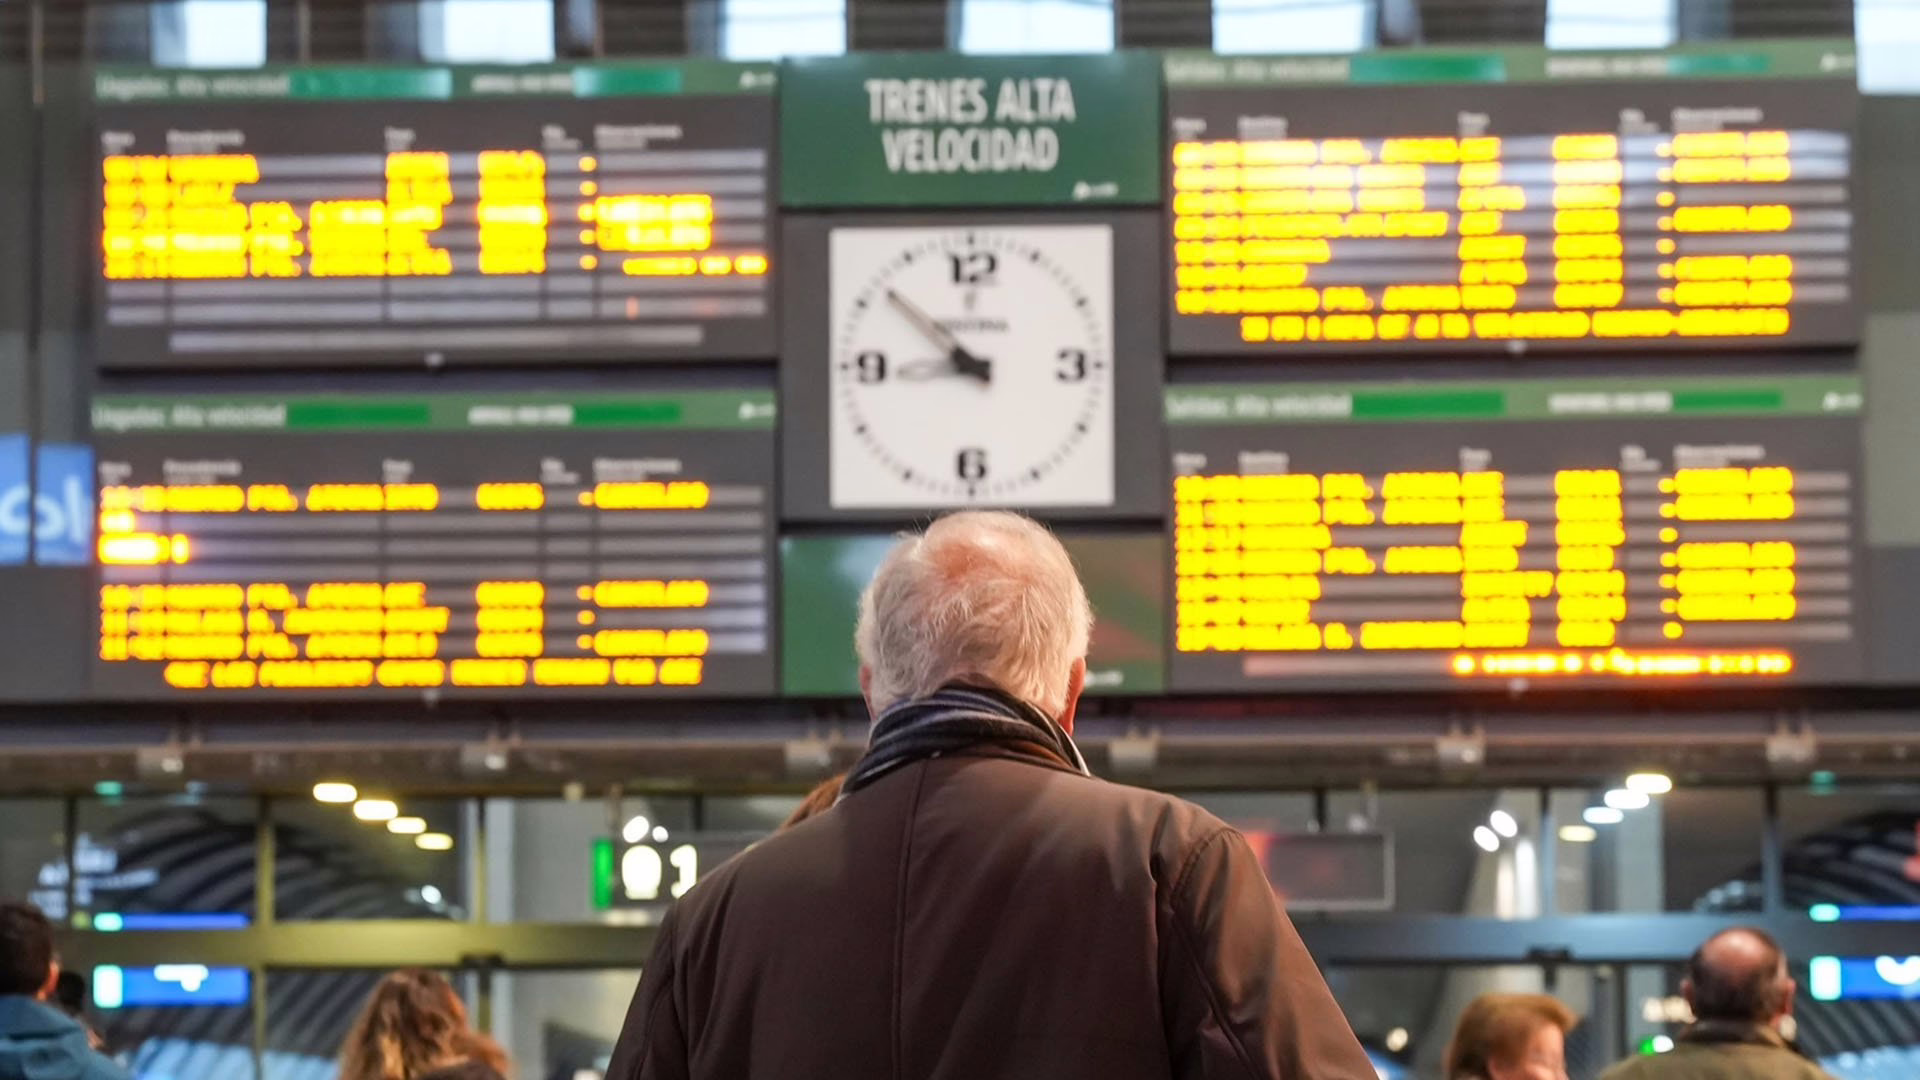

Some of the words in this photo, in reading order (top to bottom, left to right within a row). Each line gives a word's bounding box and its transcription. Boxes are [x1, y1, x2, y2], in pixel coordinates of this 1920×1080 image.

[865, 78, 987, 123] TRENES
[996, 77, 1076, 122] ALTA
[882, 127, 1059, 173] VELOCIDAD
[950, 253, 997, 284] 12
[856, 352, 887, 384] 9
[1057, 350, 1087, 381] 3
[956, 449, 987, 481] 6
